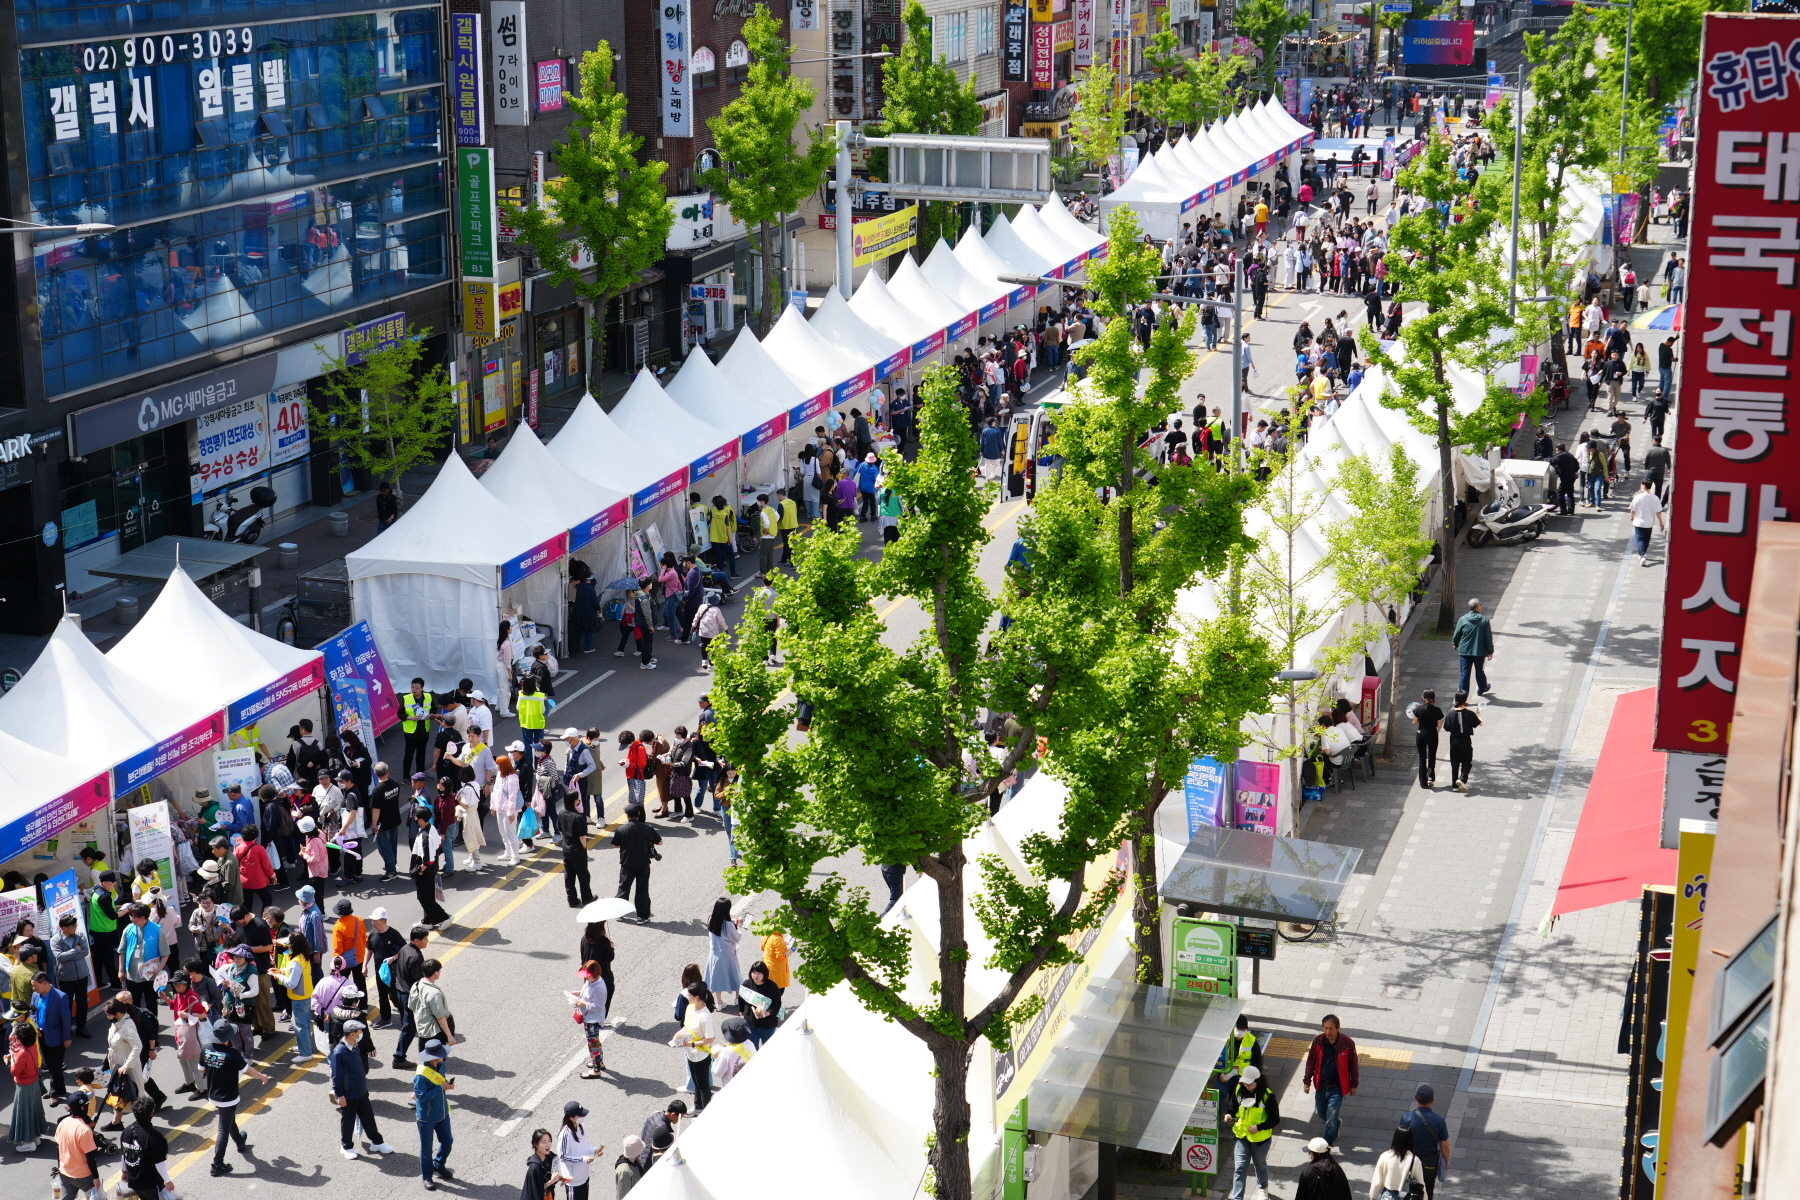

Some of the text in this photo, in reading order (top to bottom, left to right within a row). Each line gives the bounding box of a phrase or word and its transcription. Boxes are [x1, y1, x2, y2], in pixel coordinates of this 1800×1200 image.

[497, 15, 517, 47] 썸
[665, 7, 686, 83] 아리랑
[84, 27, 253, 71] 02)900-3039
[1035, 26, 1050, 82] 성인전화방
[457, 17, 476, 126] 갤럭시원룸텔
[498, 55, 507, 109] 7080
[507, 54, 520, 109] 라이브
[539, 63, 561, 83] 스포츠
[50, 59, 286, 140] 갤럭시 원룸텔
[540, 85, 562, 107] 마사지
[670, 87, 682, 123] 노래방
[458, 136, 480, 144] 3039
[468, 175, 483, 247] 골프존파크
[472, 265, 484, 273] B1
[473, 297, 485, 331] 부동산
[499, 288, 521, 312] 동산
[161, 379, 237, 420] MG새마을금고
[204, 400, 255, 427] 강북새마을금고 최초
[198, 431, 226, 456] 경영평가
[227, 422, 255, 446] 연도대상
[200, 454, 234, 483] 우수상
[236, 445, 258, 470] 수상
[329, 661, 353, 681] 화장실
[355, 649, 376, 665] 의료부스
[155, 753, 167, 767] 작은
[168, 746, 180, 760] 비닐
[181, 742, 188, 754] 한
[1187, 777, 1209, 788] 2024
[46, 810, 58, 823] 안전
[58, 800, 74, 815] 도우미
[1179, 962, 1227, 976] 마을버스승차장
